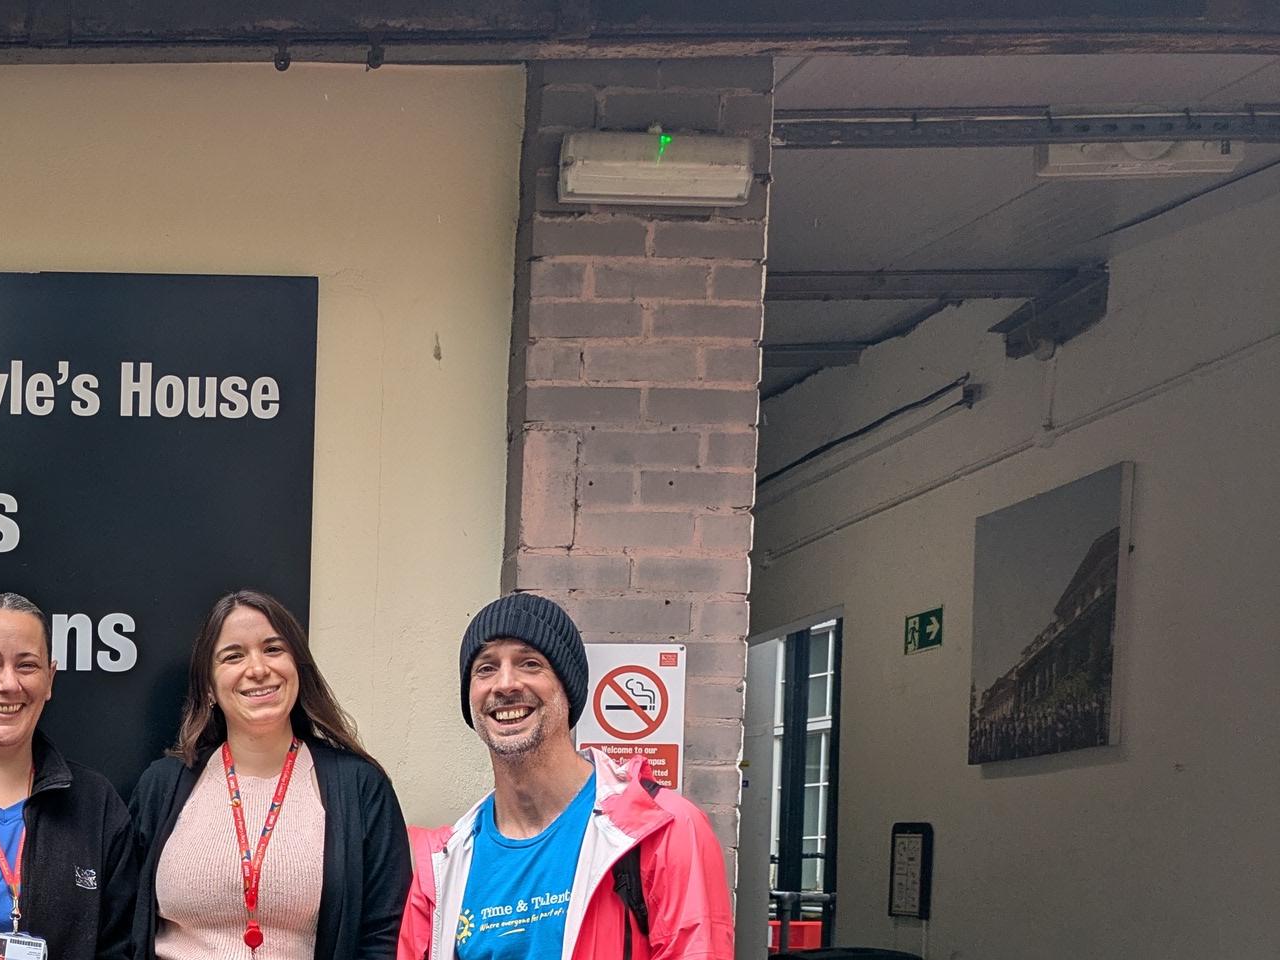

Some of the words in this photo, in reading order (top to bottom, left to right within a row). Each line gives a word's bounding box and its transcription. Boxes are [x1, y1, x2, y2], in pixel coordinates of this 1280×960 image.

[119, 361, 281, 419] House
[601, 745, 633, 754] Welcome
[634, 746, 643, 754] to
[480, 905, 513, 920] Time
[515, 899, 528, 913] &
